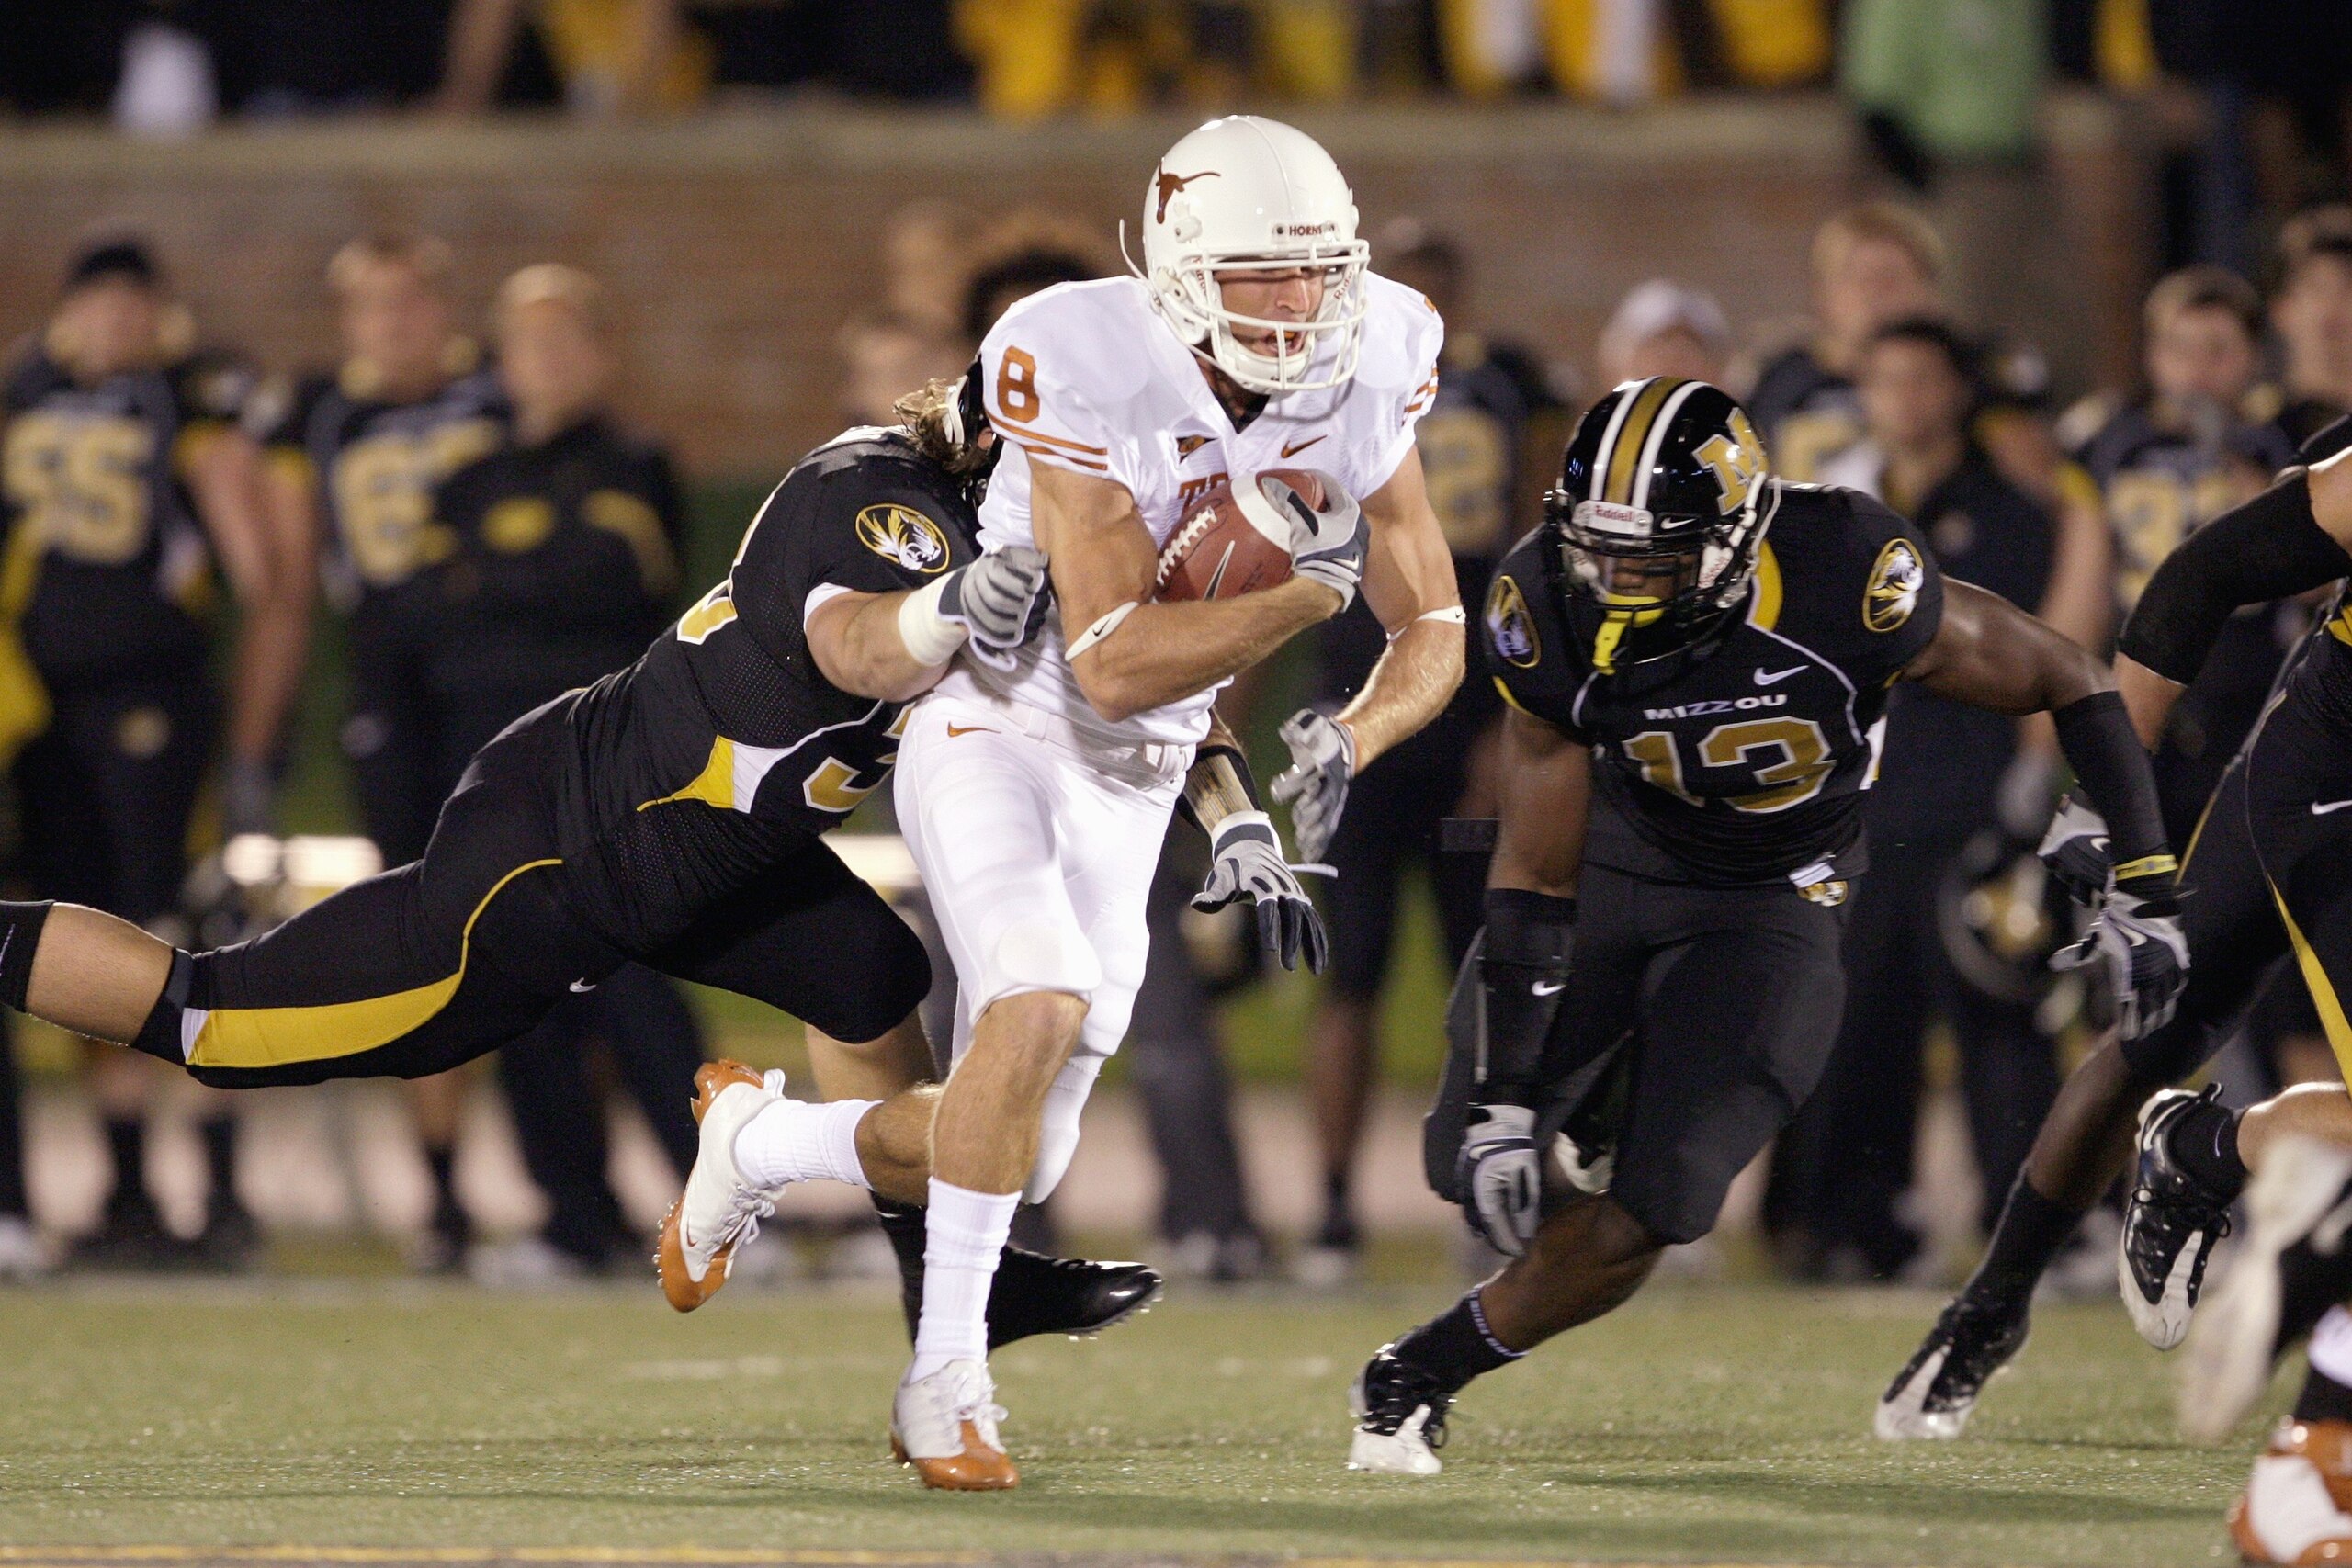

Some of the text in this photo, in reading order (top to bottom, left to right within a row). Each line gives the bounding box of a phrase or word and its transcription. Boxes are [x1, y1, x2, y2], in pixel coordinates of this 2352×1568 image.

[1289, 225, 1322, 236] HORNS
[997, 344, 1040, 423] 8
[1691, 406, 1770, 516] M
[1642, 694, 1788, 721] MIZZOU
[1622, 716, 1838, 814] 13
